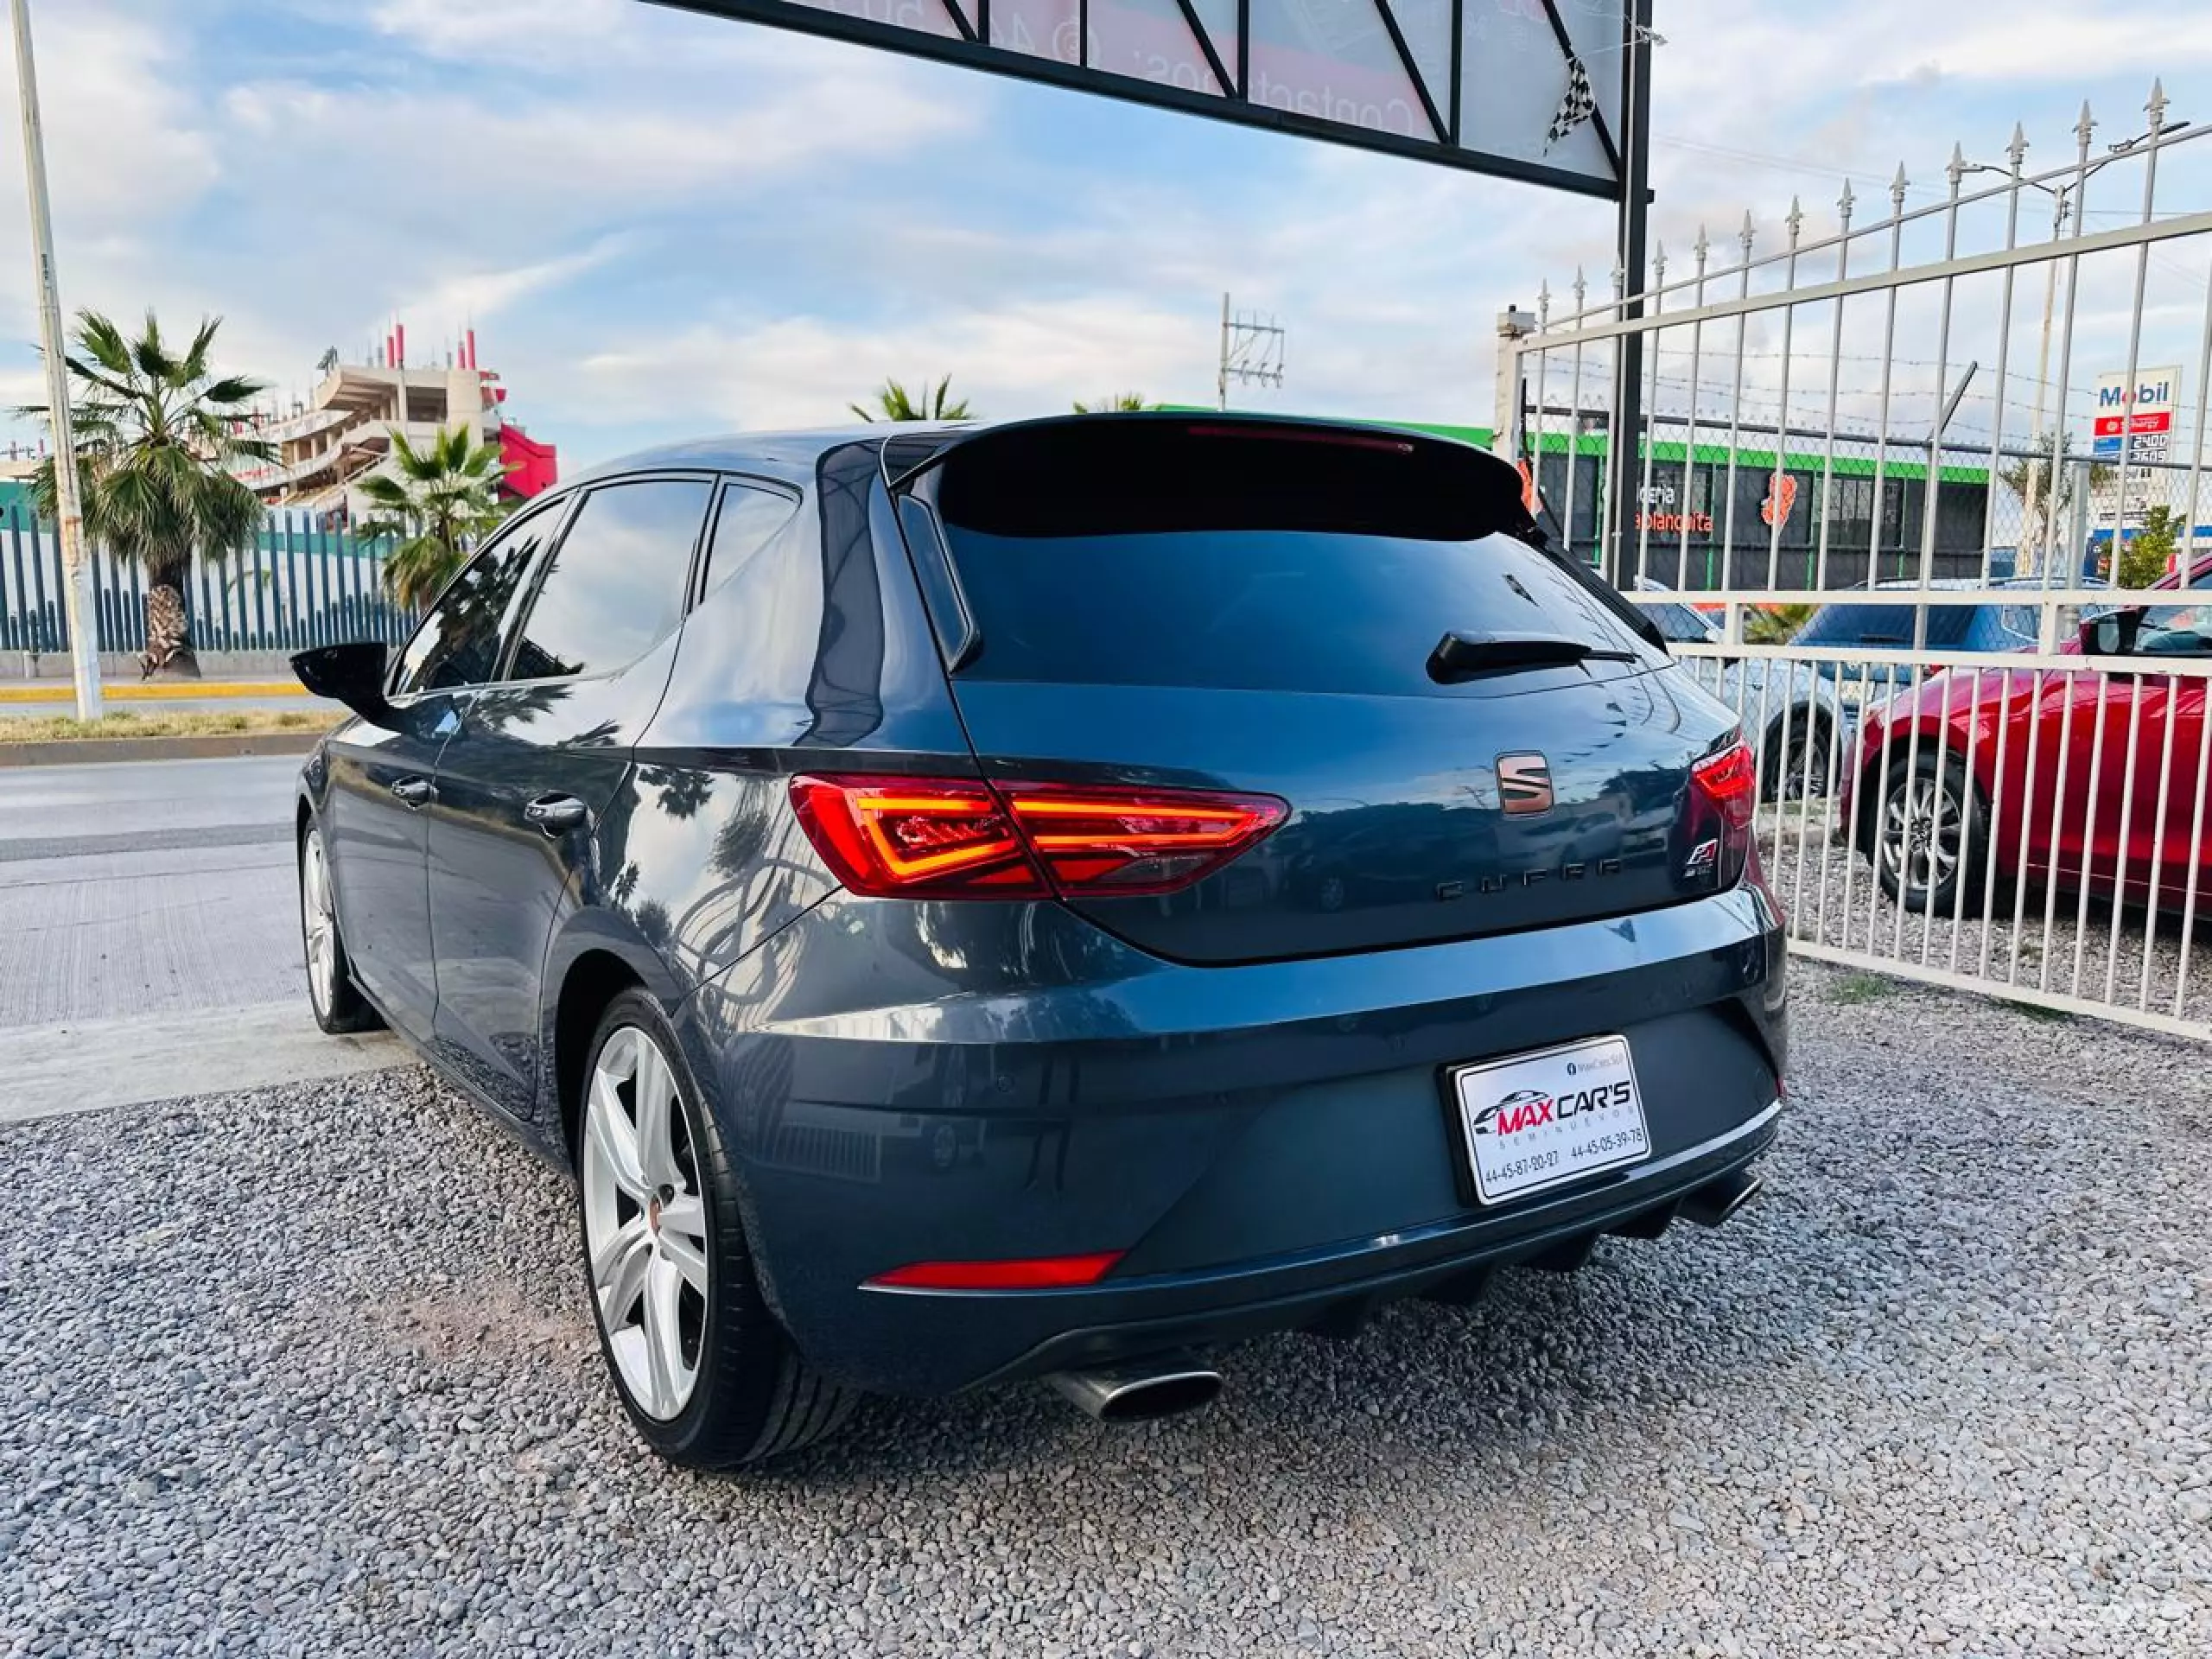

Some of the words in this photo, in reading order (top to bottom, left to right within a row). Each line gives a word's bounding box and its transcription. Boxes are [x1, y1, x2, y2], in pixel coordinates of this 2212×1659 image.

[2100, 381, 2169, 407] Mobil
[1498, 1098, 1554, 1135] MAX
[1557, 1080, 1630, 1119] CAR'S
[1571, 1127, 1643, 1157] 44-45-05-39-78
